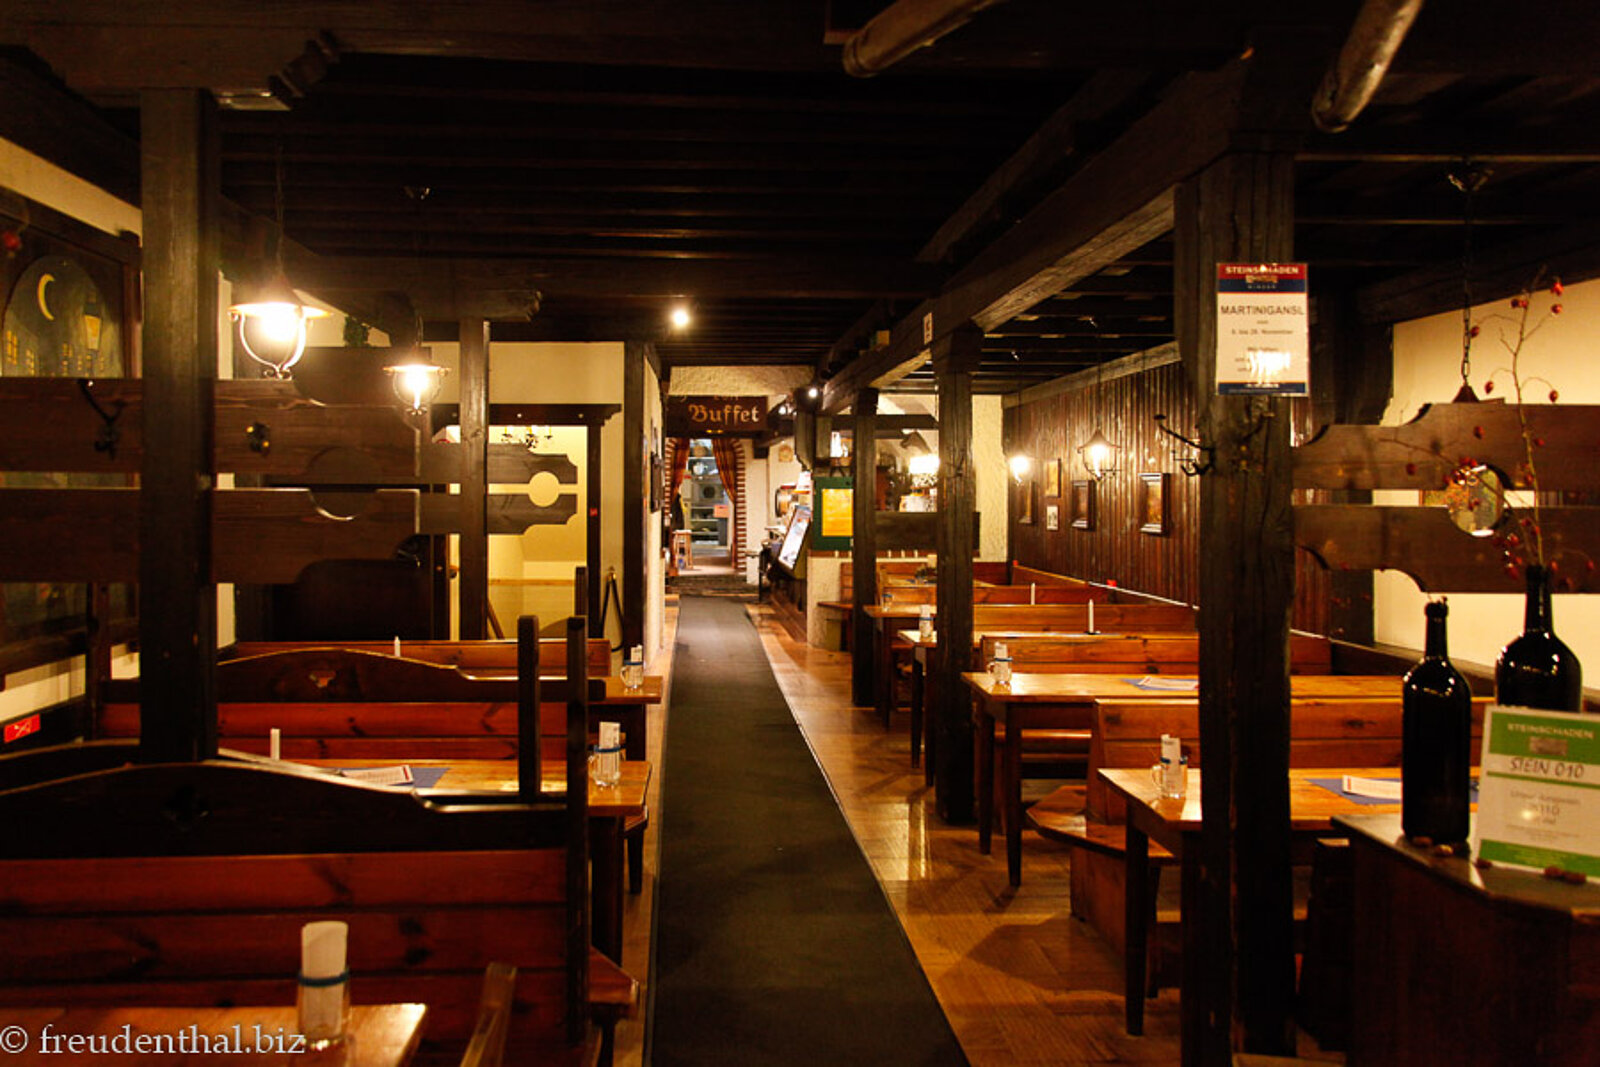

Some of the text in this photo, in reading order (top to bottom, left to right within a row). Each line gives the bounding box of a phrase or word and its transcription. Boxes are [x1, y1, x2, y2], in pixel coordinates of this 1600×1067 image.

[1221, 305, 1304, 315] MARTINIGANSL
[687, 404, 759, 425] Buffet
[1510, 756, 1550, 775] STEIN
